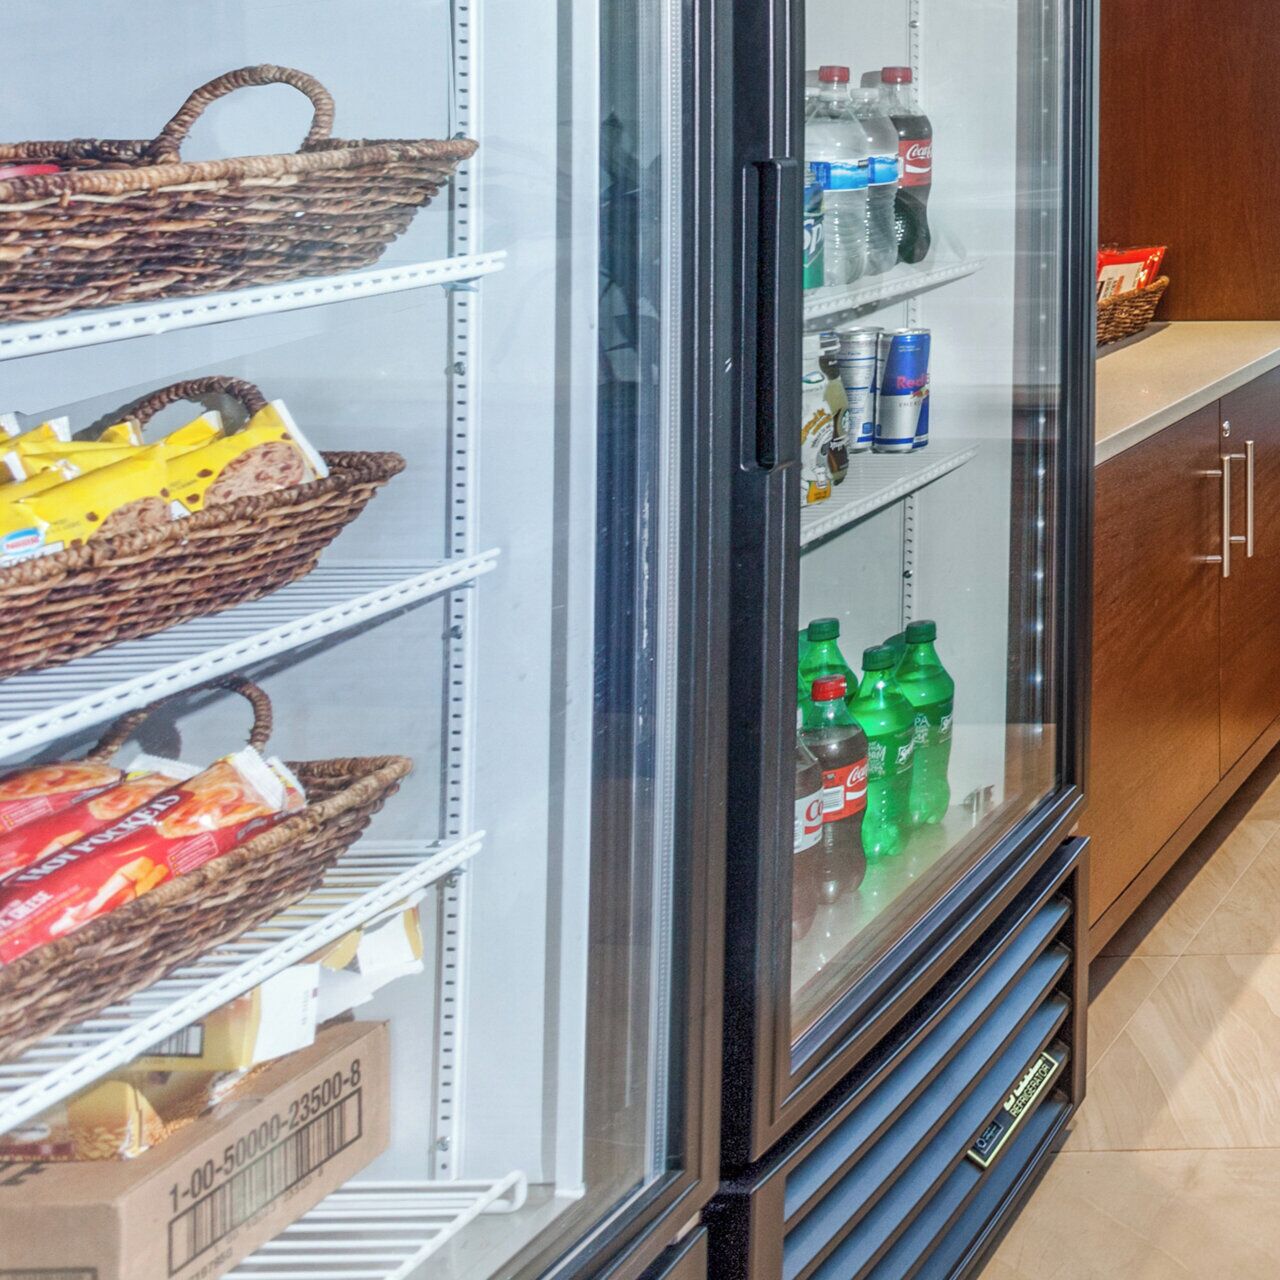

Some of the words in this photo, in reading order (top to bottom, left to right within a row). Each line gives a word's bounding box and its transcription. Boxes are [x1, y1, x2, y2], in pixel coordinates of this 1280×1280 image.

[16, 852, 80, 882] HOT
[70, 794, 182, 854] POCKETS
[1009, 1063, 1051, 1118] REFRIGERATOR
[169, 1058, 362, 1213] 1-00-50000-23500-8
